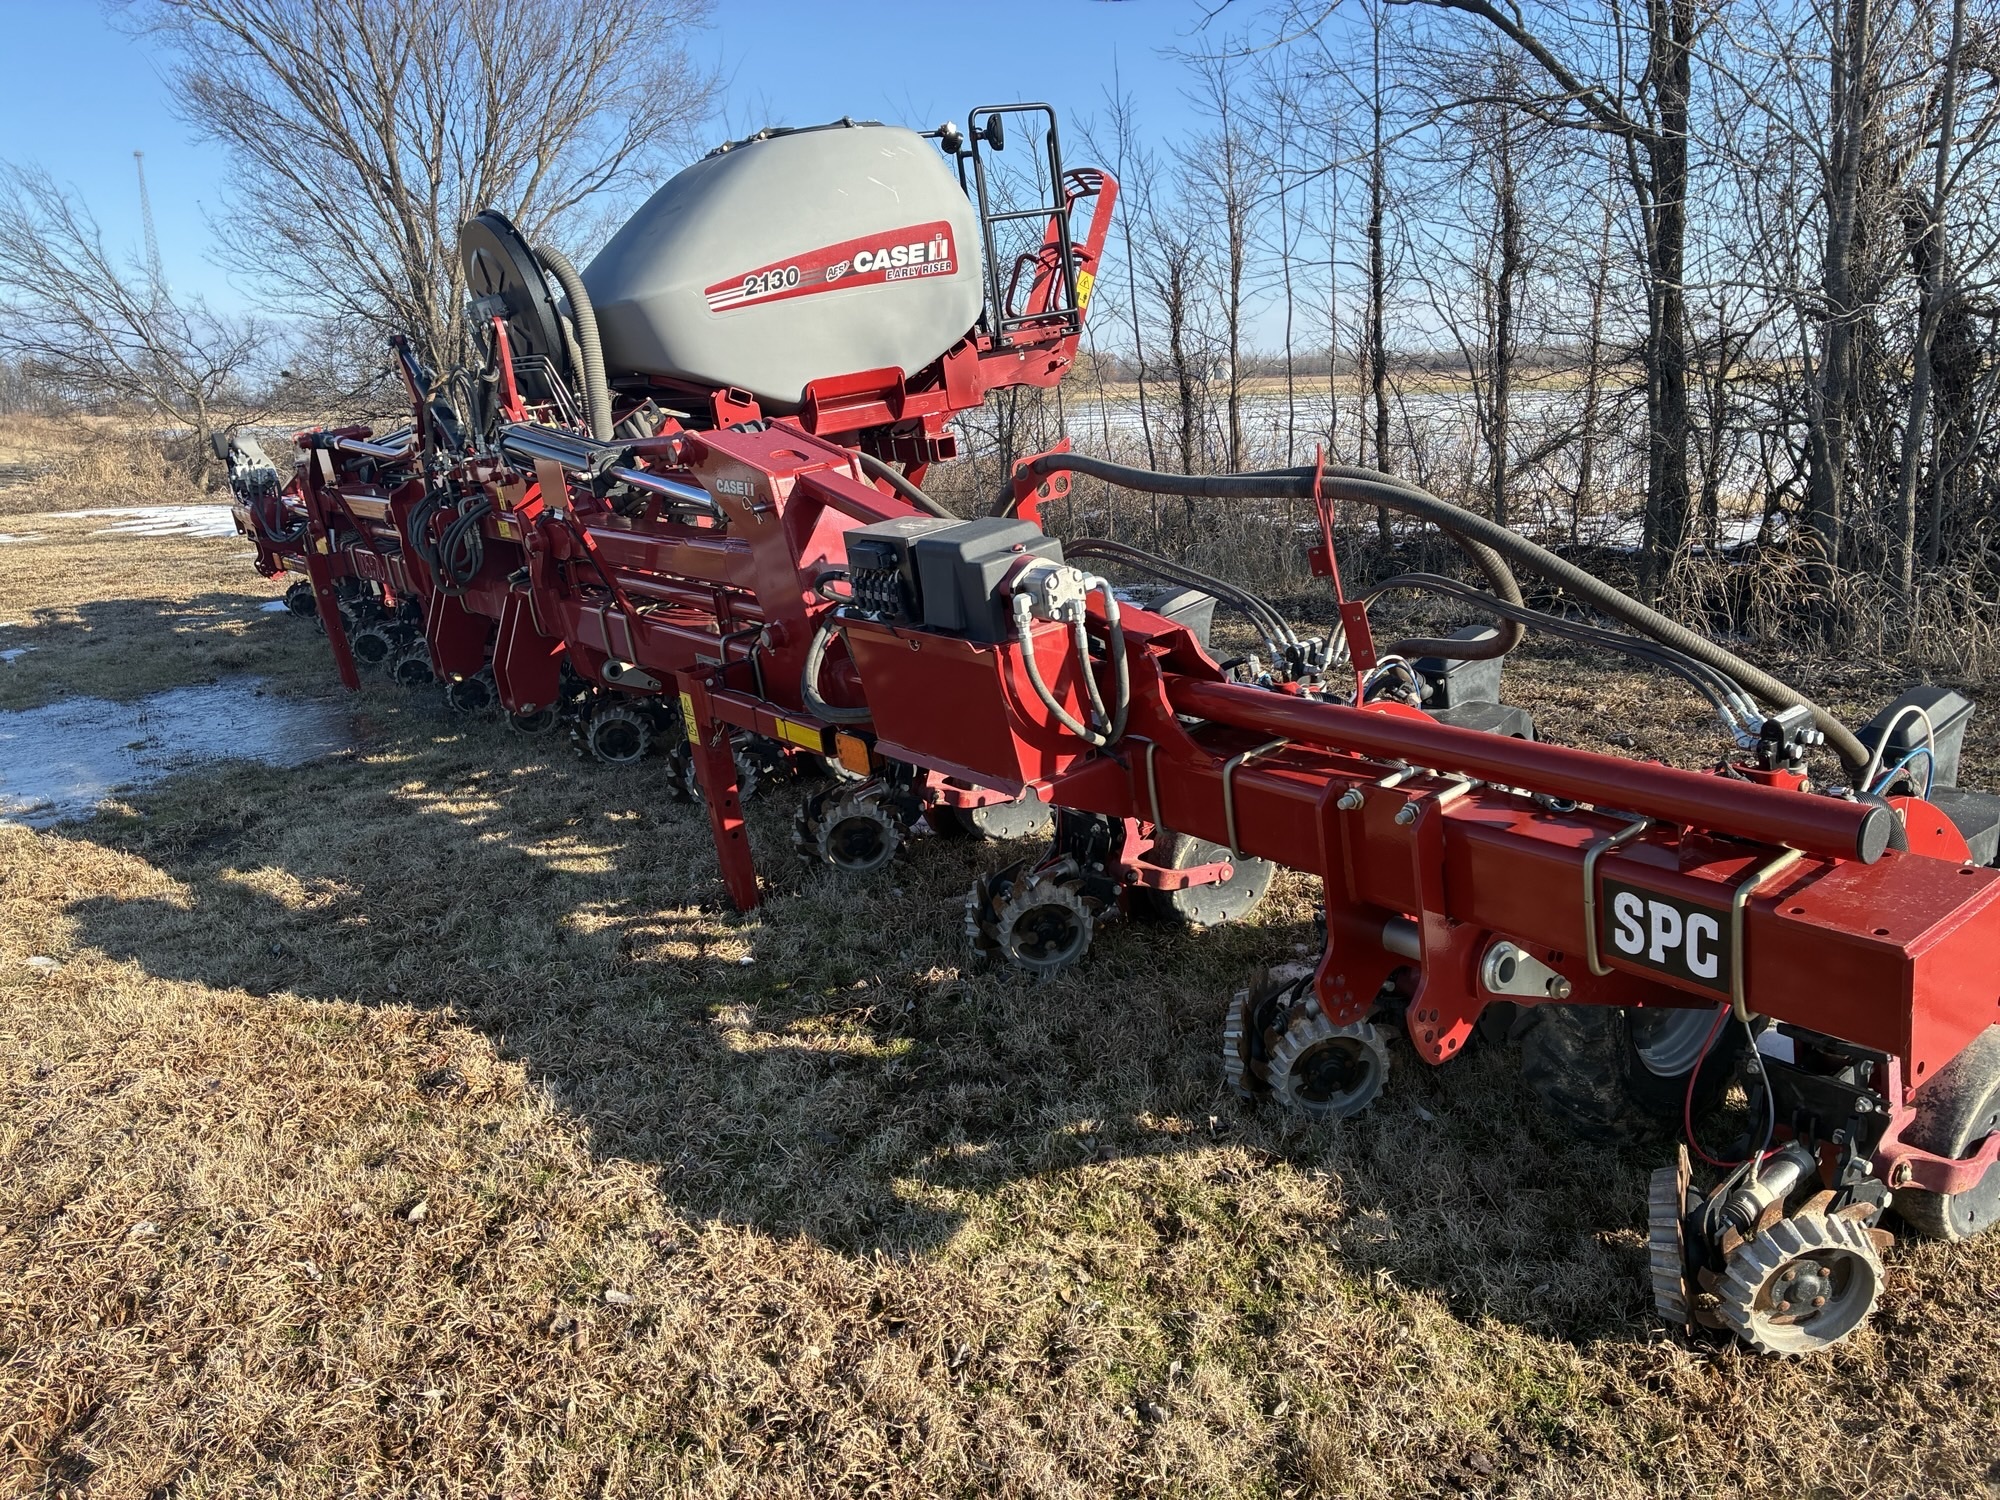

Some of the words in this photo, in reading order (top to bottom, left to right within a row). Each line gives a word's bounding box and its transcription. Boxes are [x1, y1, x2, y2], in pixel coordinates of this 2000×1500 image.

[853, 242, 925, 273] CASE
[886, 264, 920, 280] EARLY
[922, 260, 952, 275] RISER
[744, 267, 799, 296] 2130
[716, 479, 744, 496] CASE
[1613, 891, 1719, 979] SPC
